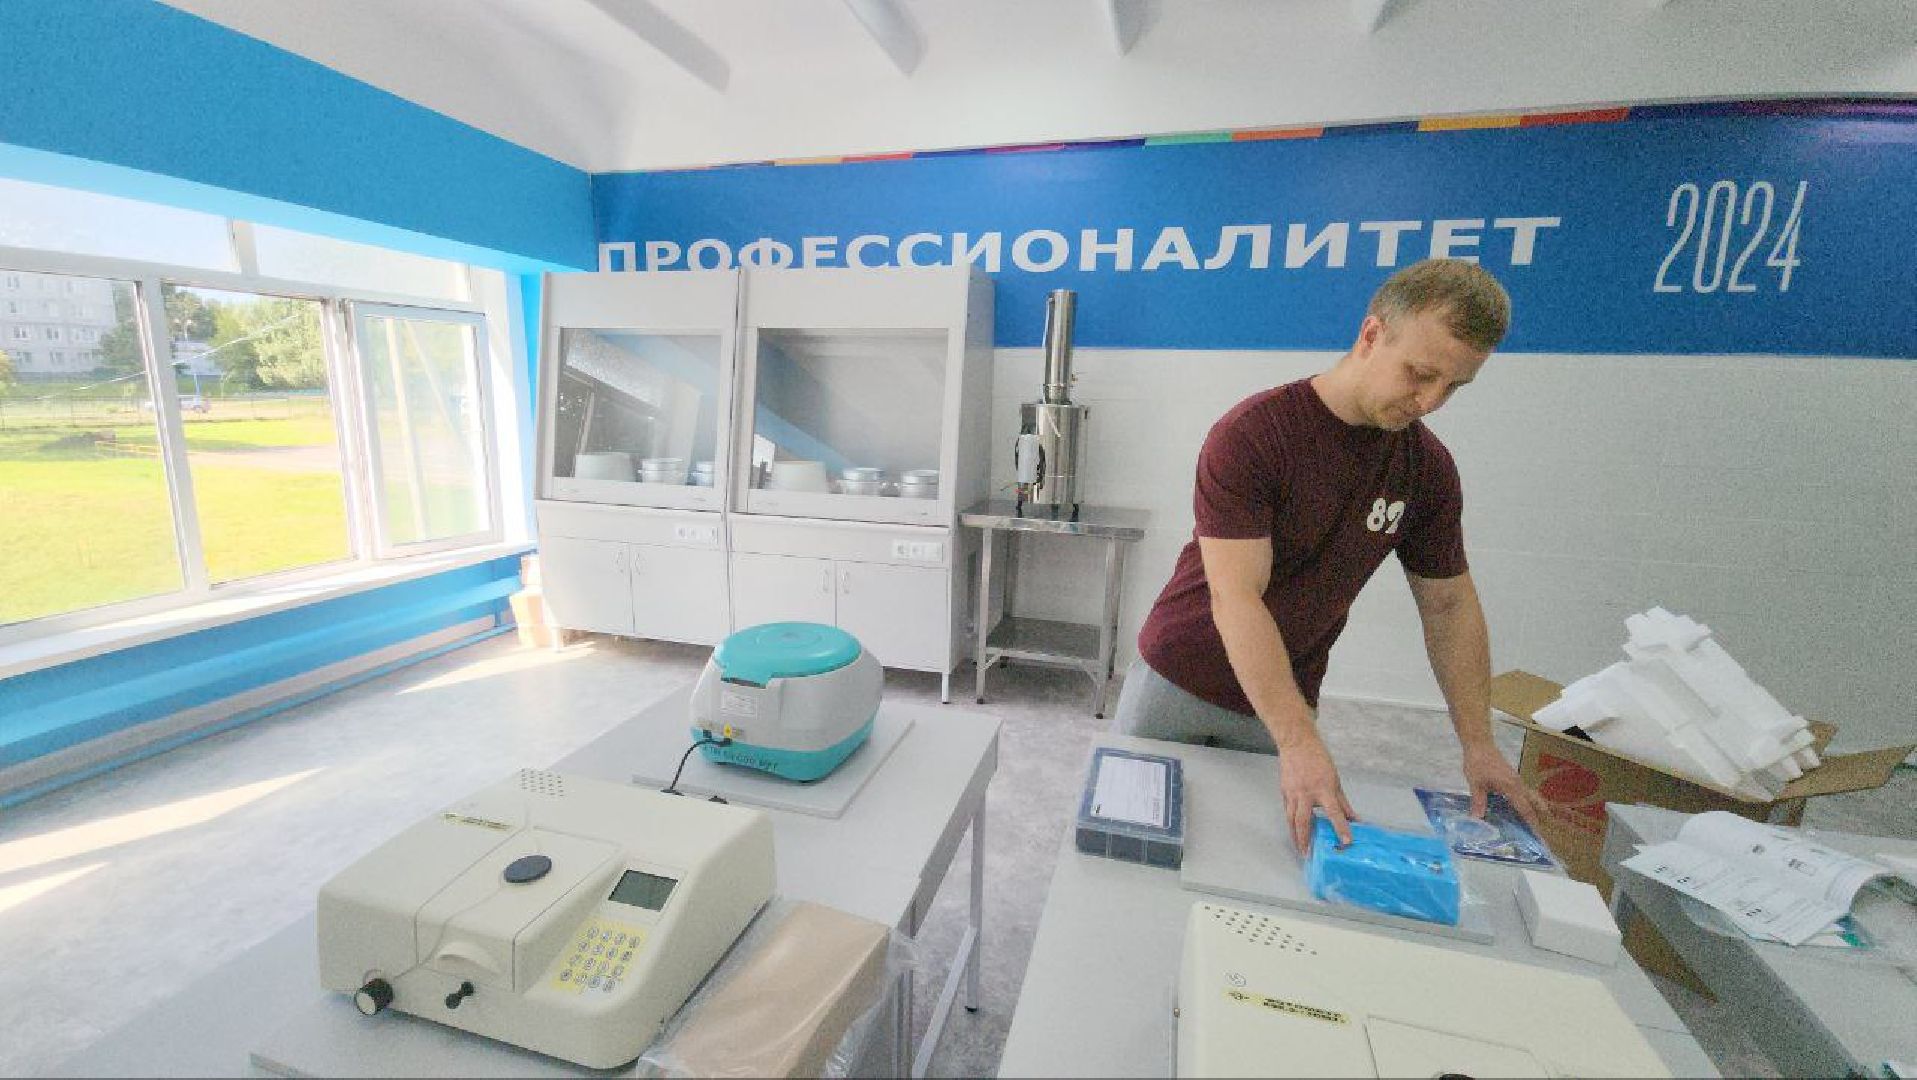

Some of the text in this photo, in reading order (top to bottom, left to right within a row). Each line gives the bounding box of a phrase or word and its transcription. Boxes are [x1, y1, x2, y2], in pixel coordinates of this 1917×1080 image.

[599, 217, 1560, 272] ПРОФЕССИОНАЛИТЕТ
[1654, 181, 1807, 292] 2024
[1367, 498, 1405, 534] 89
